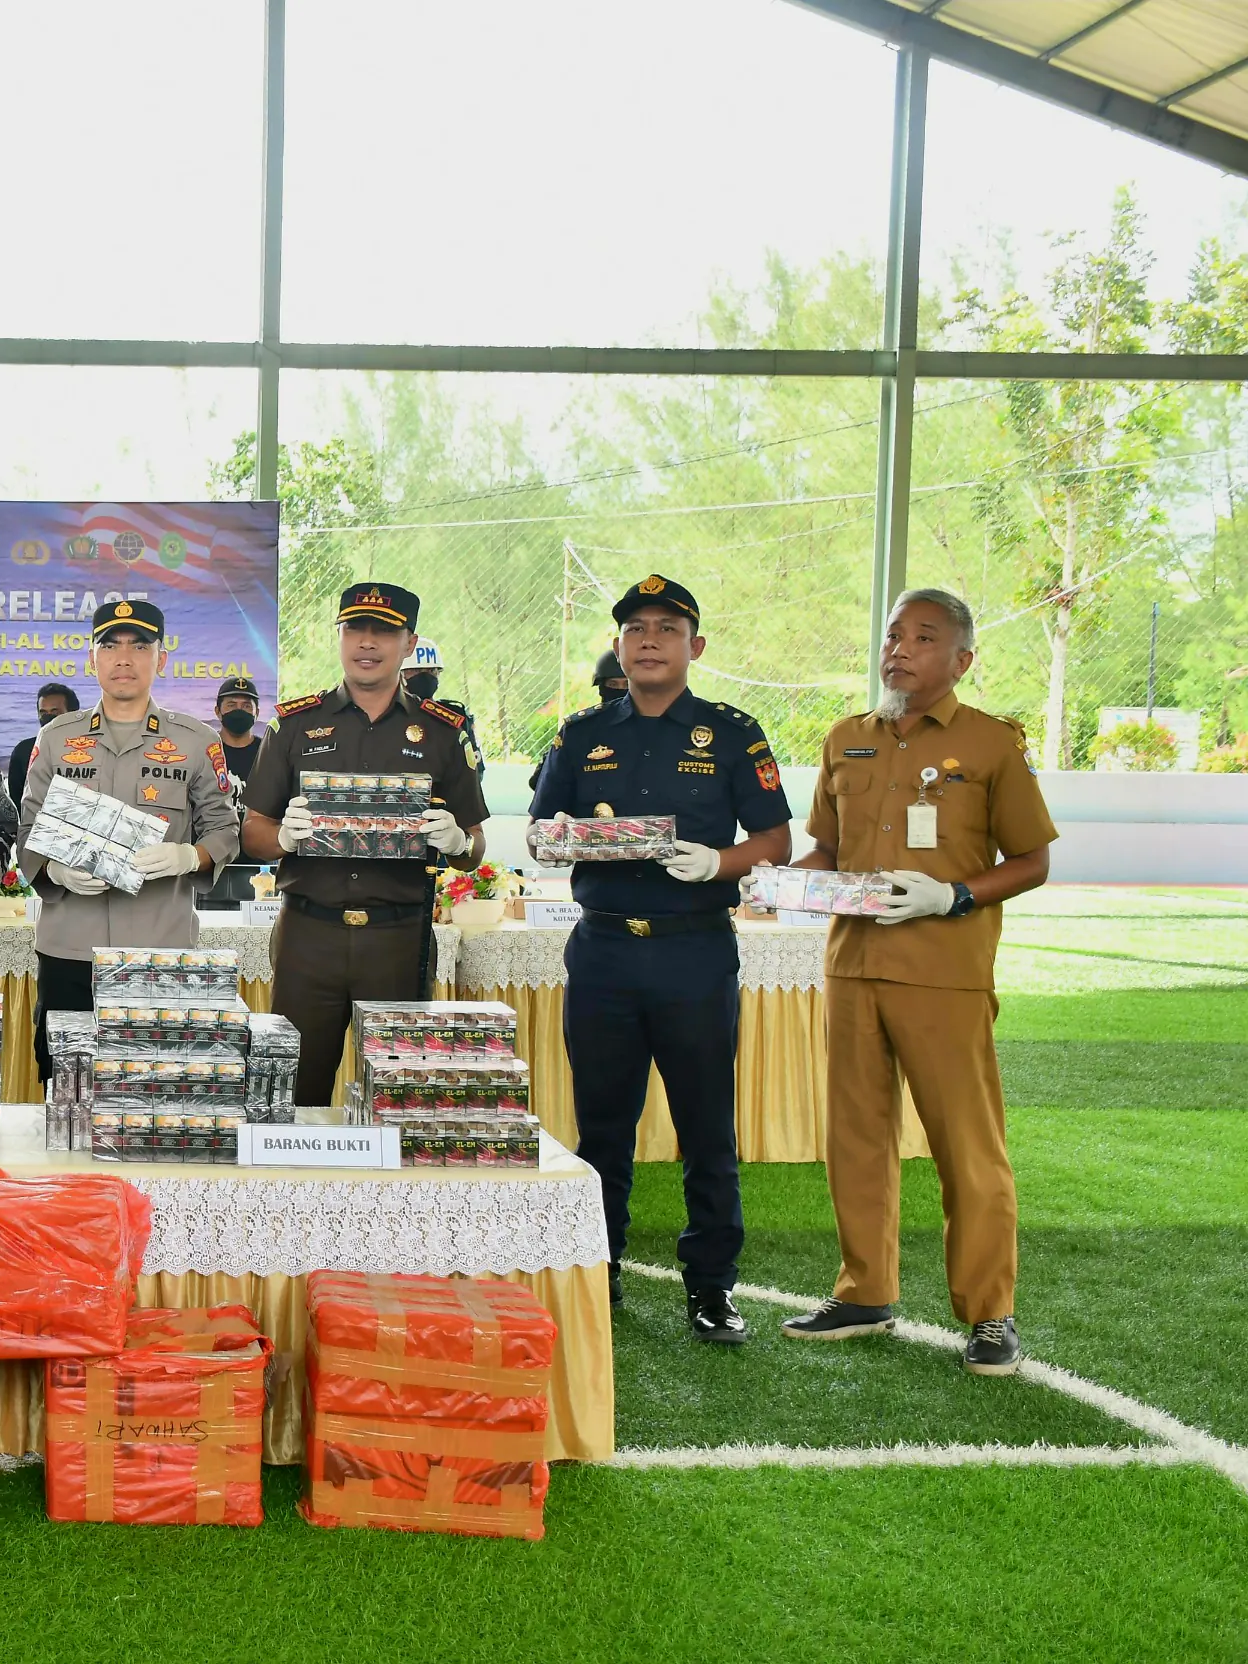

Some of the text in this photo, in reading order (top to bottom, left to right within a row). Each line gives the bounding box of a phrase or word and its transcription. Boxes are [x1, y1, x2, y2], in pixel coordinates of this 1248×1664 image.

[416, 647, 437, 664] PM
[173, 661, 254, 679] ILEGAL
[677, 767, 715, 775] EXCISE
[678, 761, 715, 769] CUSTOMS
[141, 767, 187, 781] POLRI
[263, 1137, 370, 1151] BARANG BUKTI
